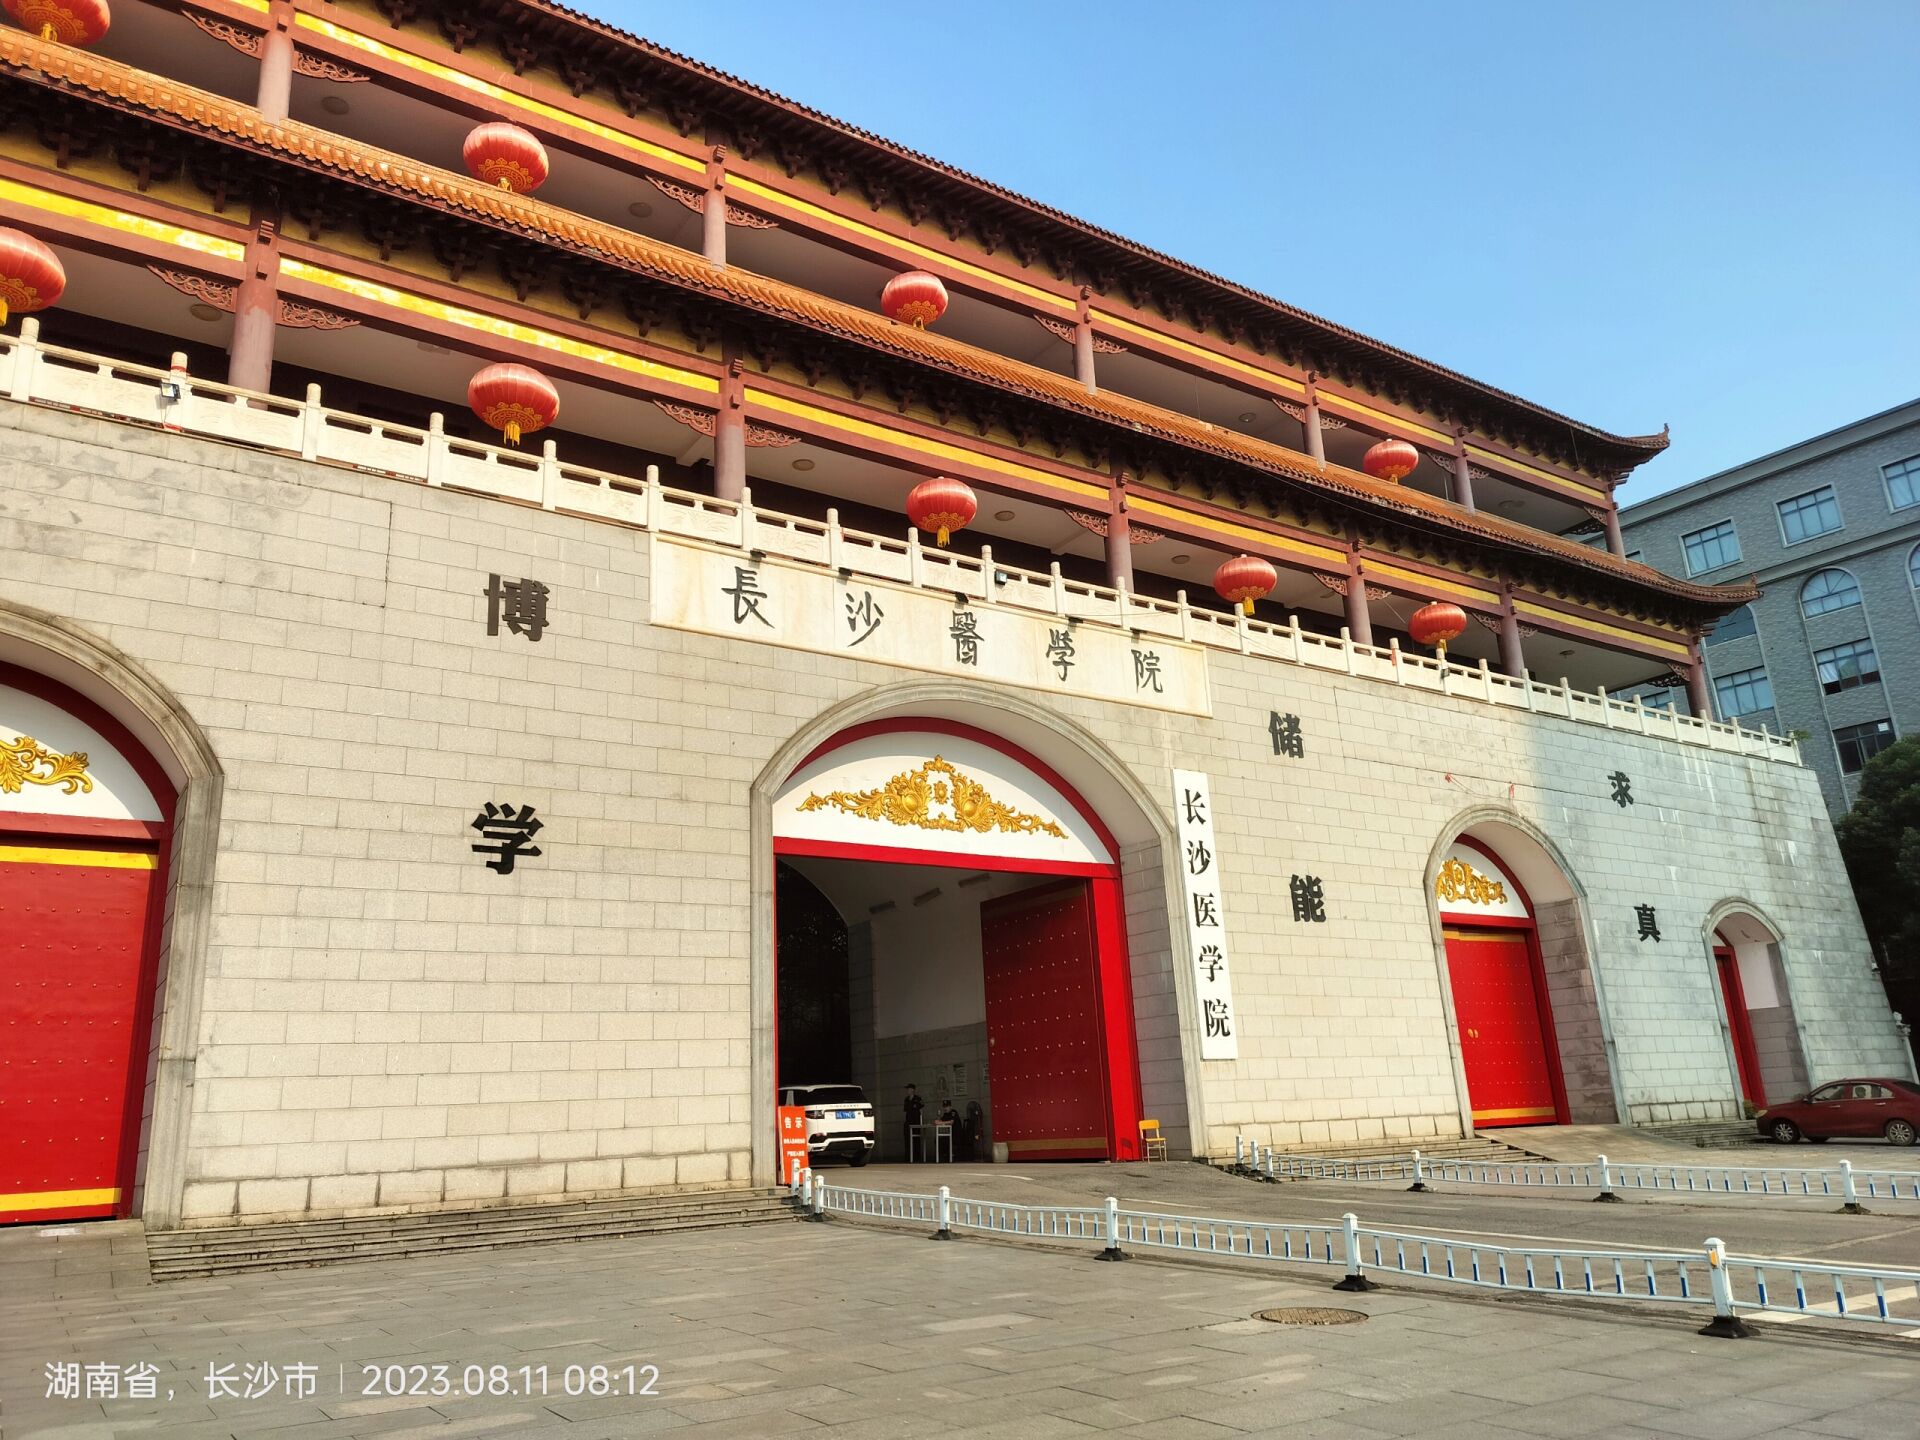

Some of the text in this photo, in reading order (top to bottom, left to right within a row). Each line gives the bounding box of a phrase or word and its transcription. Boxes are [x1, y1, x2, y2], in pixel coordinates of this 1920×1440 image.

[471, 572, 551, 875] 博学
[1268, 710, 1327, 923] 储能
[1181, 788, 1231, 1039] 长沙医学院
